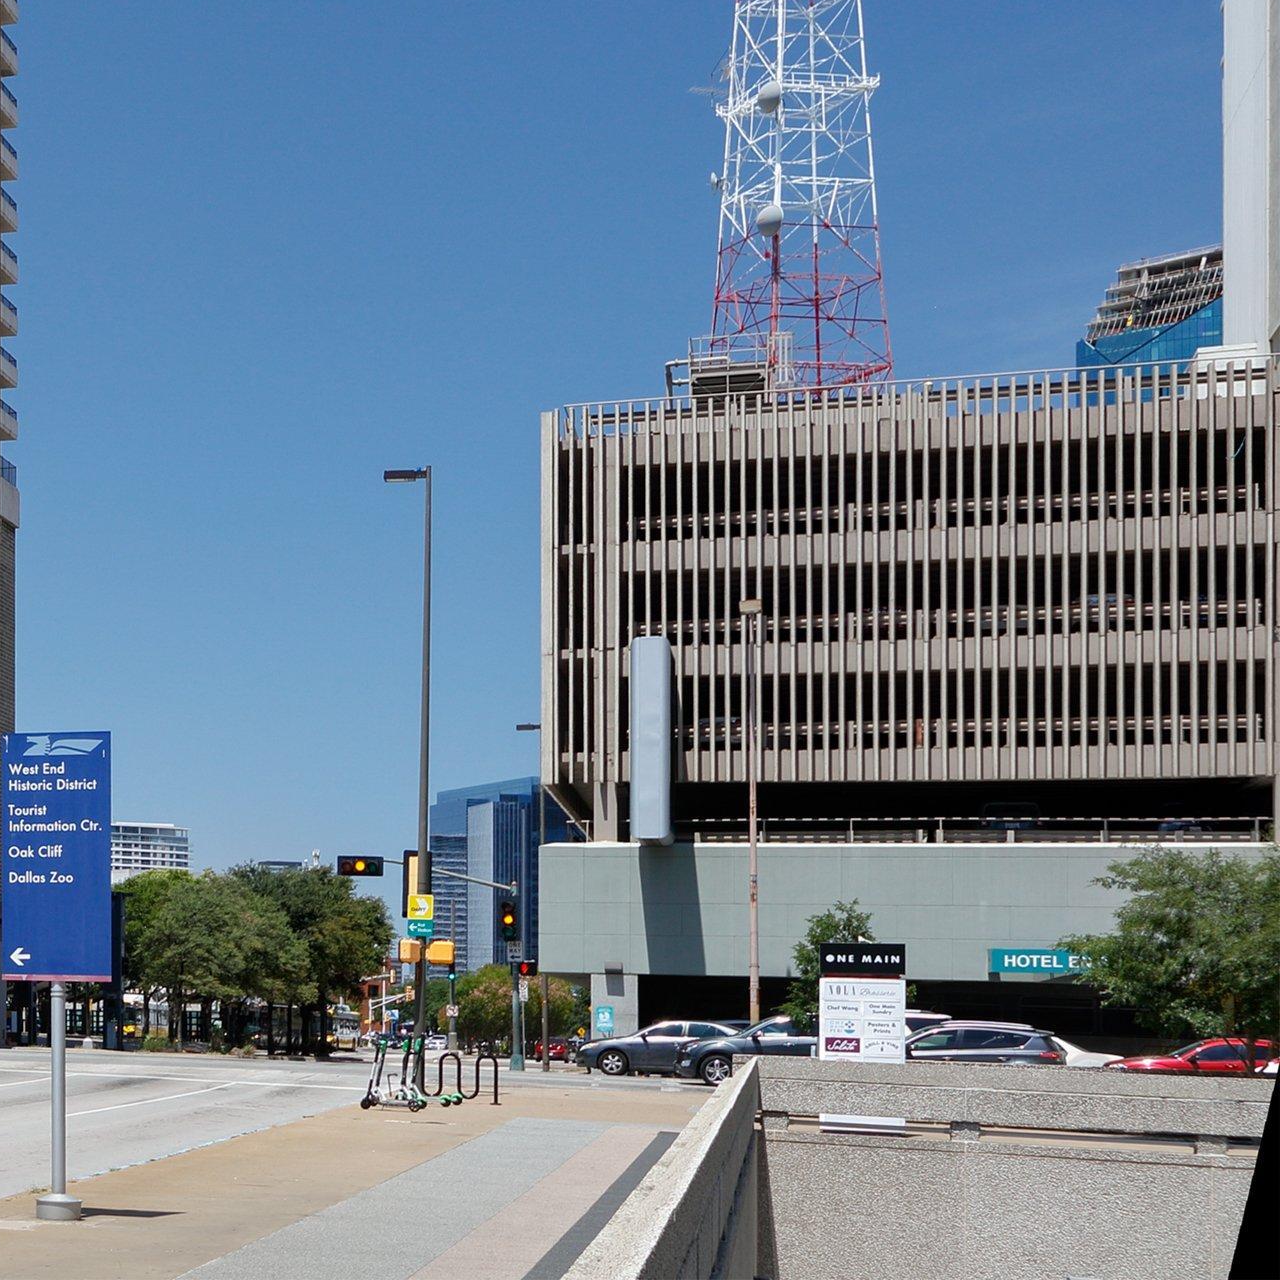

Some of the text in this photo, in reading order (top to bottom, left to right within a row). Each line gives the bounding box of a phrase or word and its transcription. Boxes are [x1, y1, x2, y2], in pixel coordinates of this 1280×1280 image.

[8, 762, 65, 775] West End
[8, 778, 98, 792] Historic District
[8, 804, 47, 816] Tourist
[8, 819, 103, 833] Information Ctr.
[8, 845, 63, 858] Oak Cliff
[8, 871, 74, 884] Dallas Zoo
[825, 954, 900, 963] ONE MAIN
[1004, 955, 1063, 968] HOTEL
